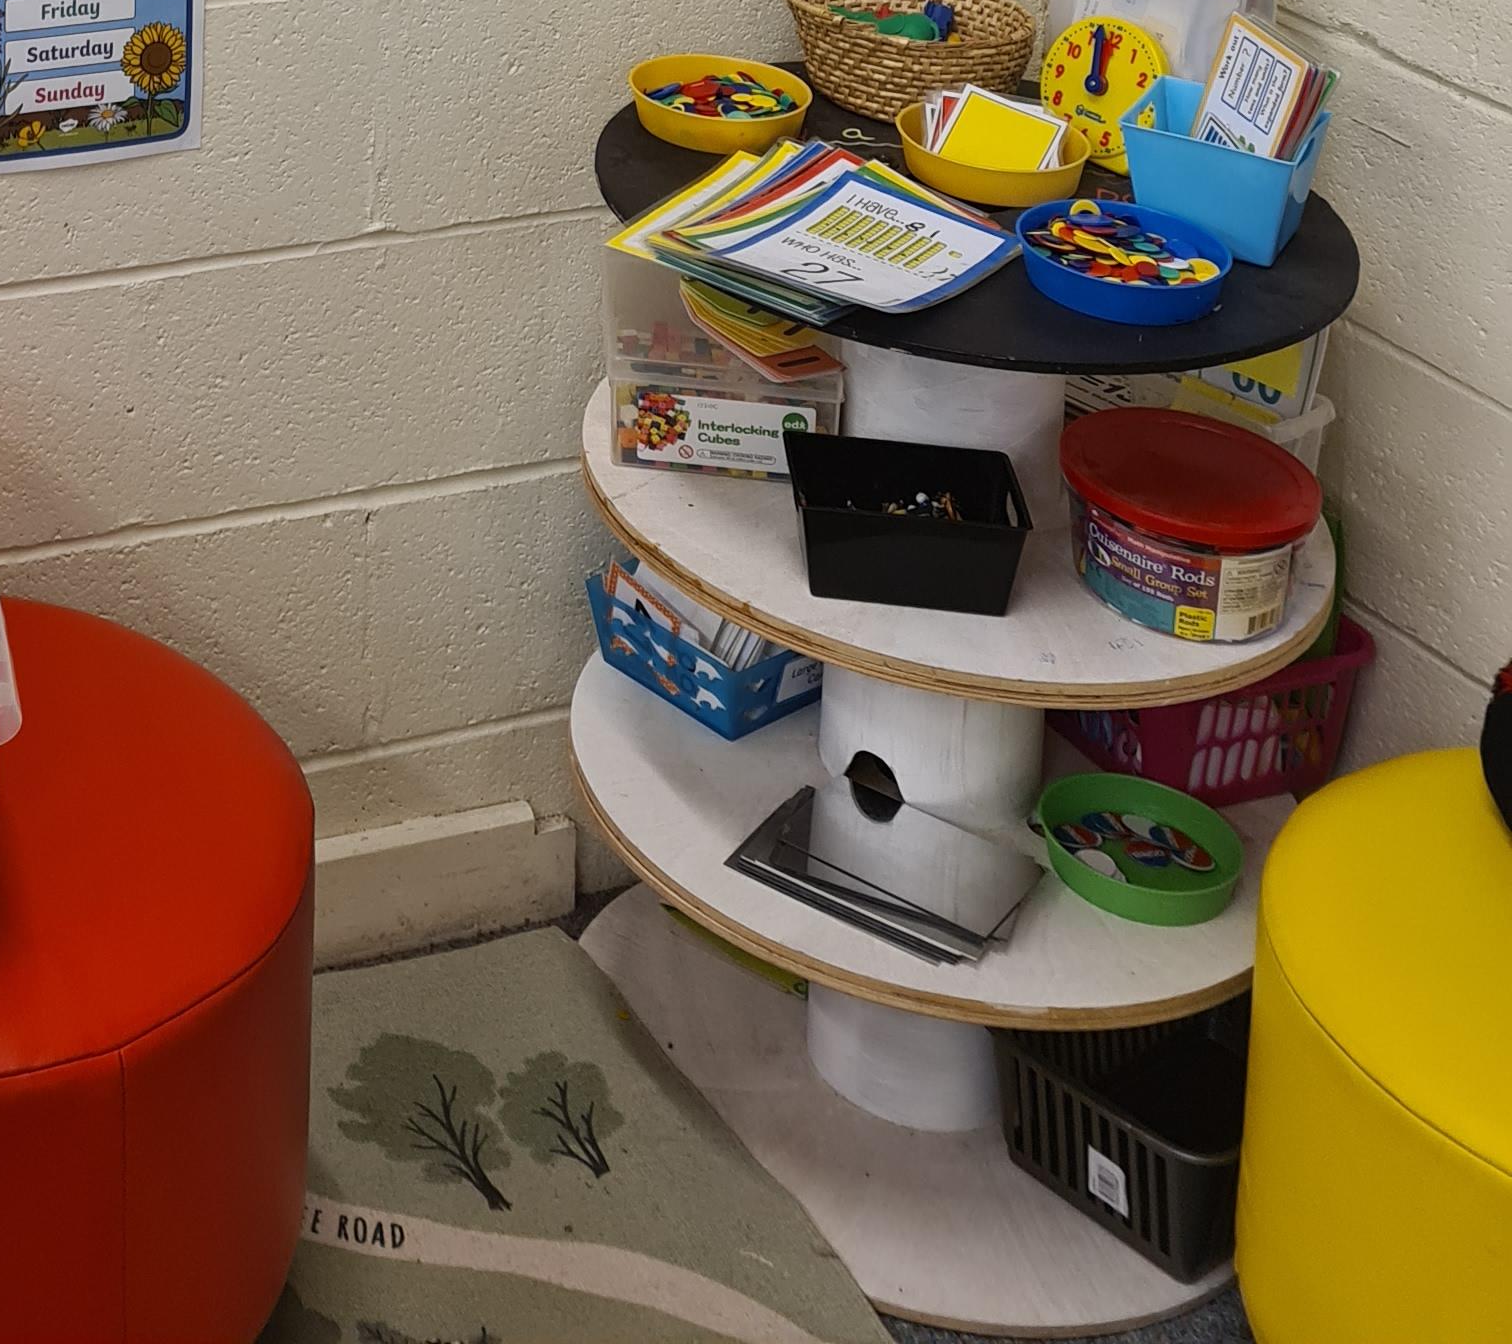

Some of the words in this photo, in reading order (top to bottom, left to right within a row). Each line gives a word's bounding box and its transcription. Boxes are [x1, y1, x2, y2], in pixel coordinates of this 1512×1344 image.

[40, 0, 101, 21] Friday
[26, 39, 114, 64] Saturday
[34, 80, 106, 104] Sunday
[698, 420, 779, 438] Interlocking
[698, 433, 740, 446] Cubes
[1089, 522, 1163, 573] Cuisenaire
[1171, 566, 1216, 587] Rods
[1111, 556, 1141, 580] Small
[1145, 576, 1182, 596] Group
[1187, 588, 1209, 600] Set
[337, 1215, 406, 1249] ROAD
